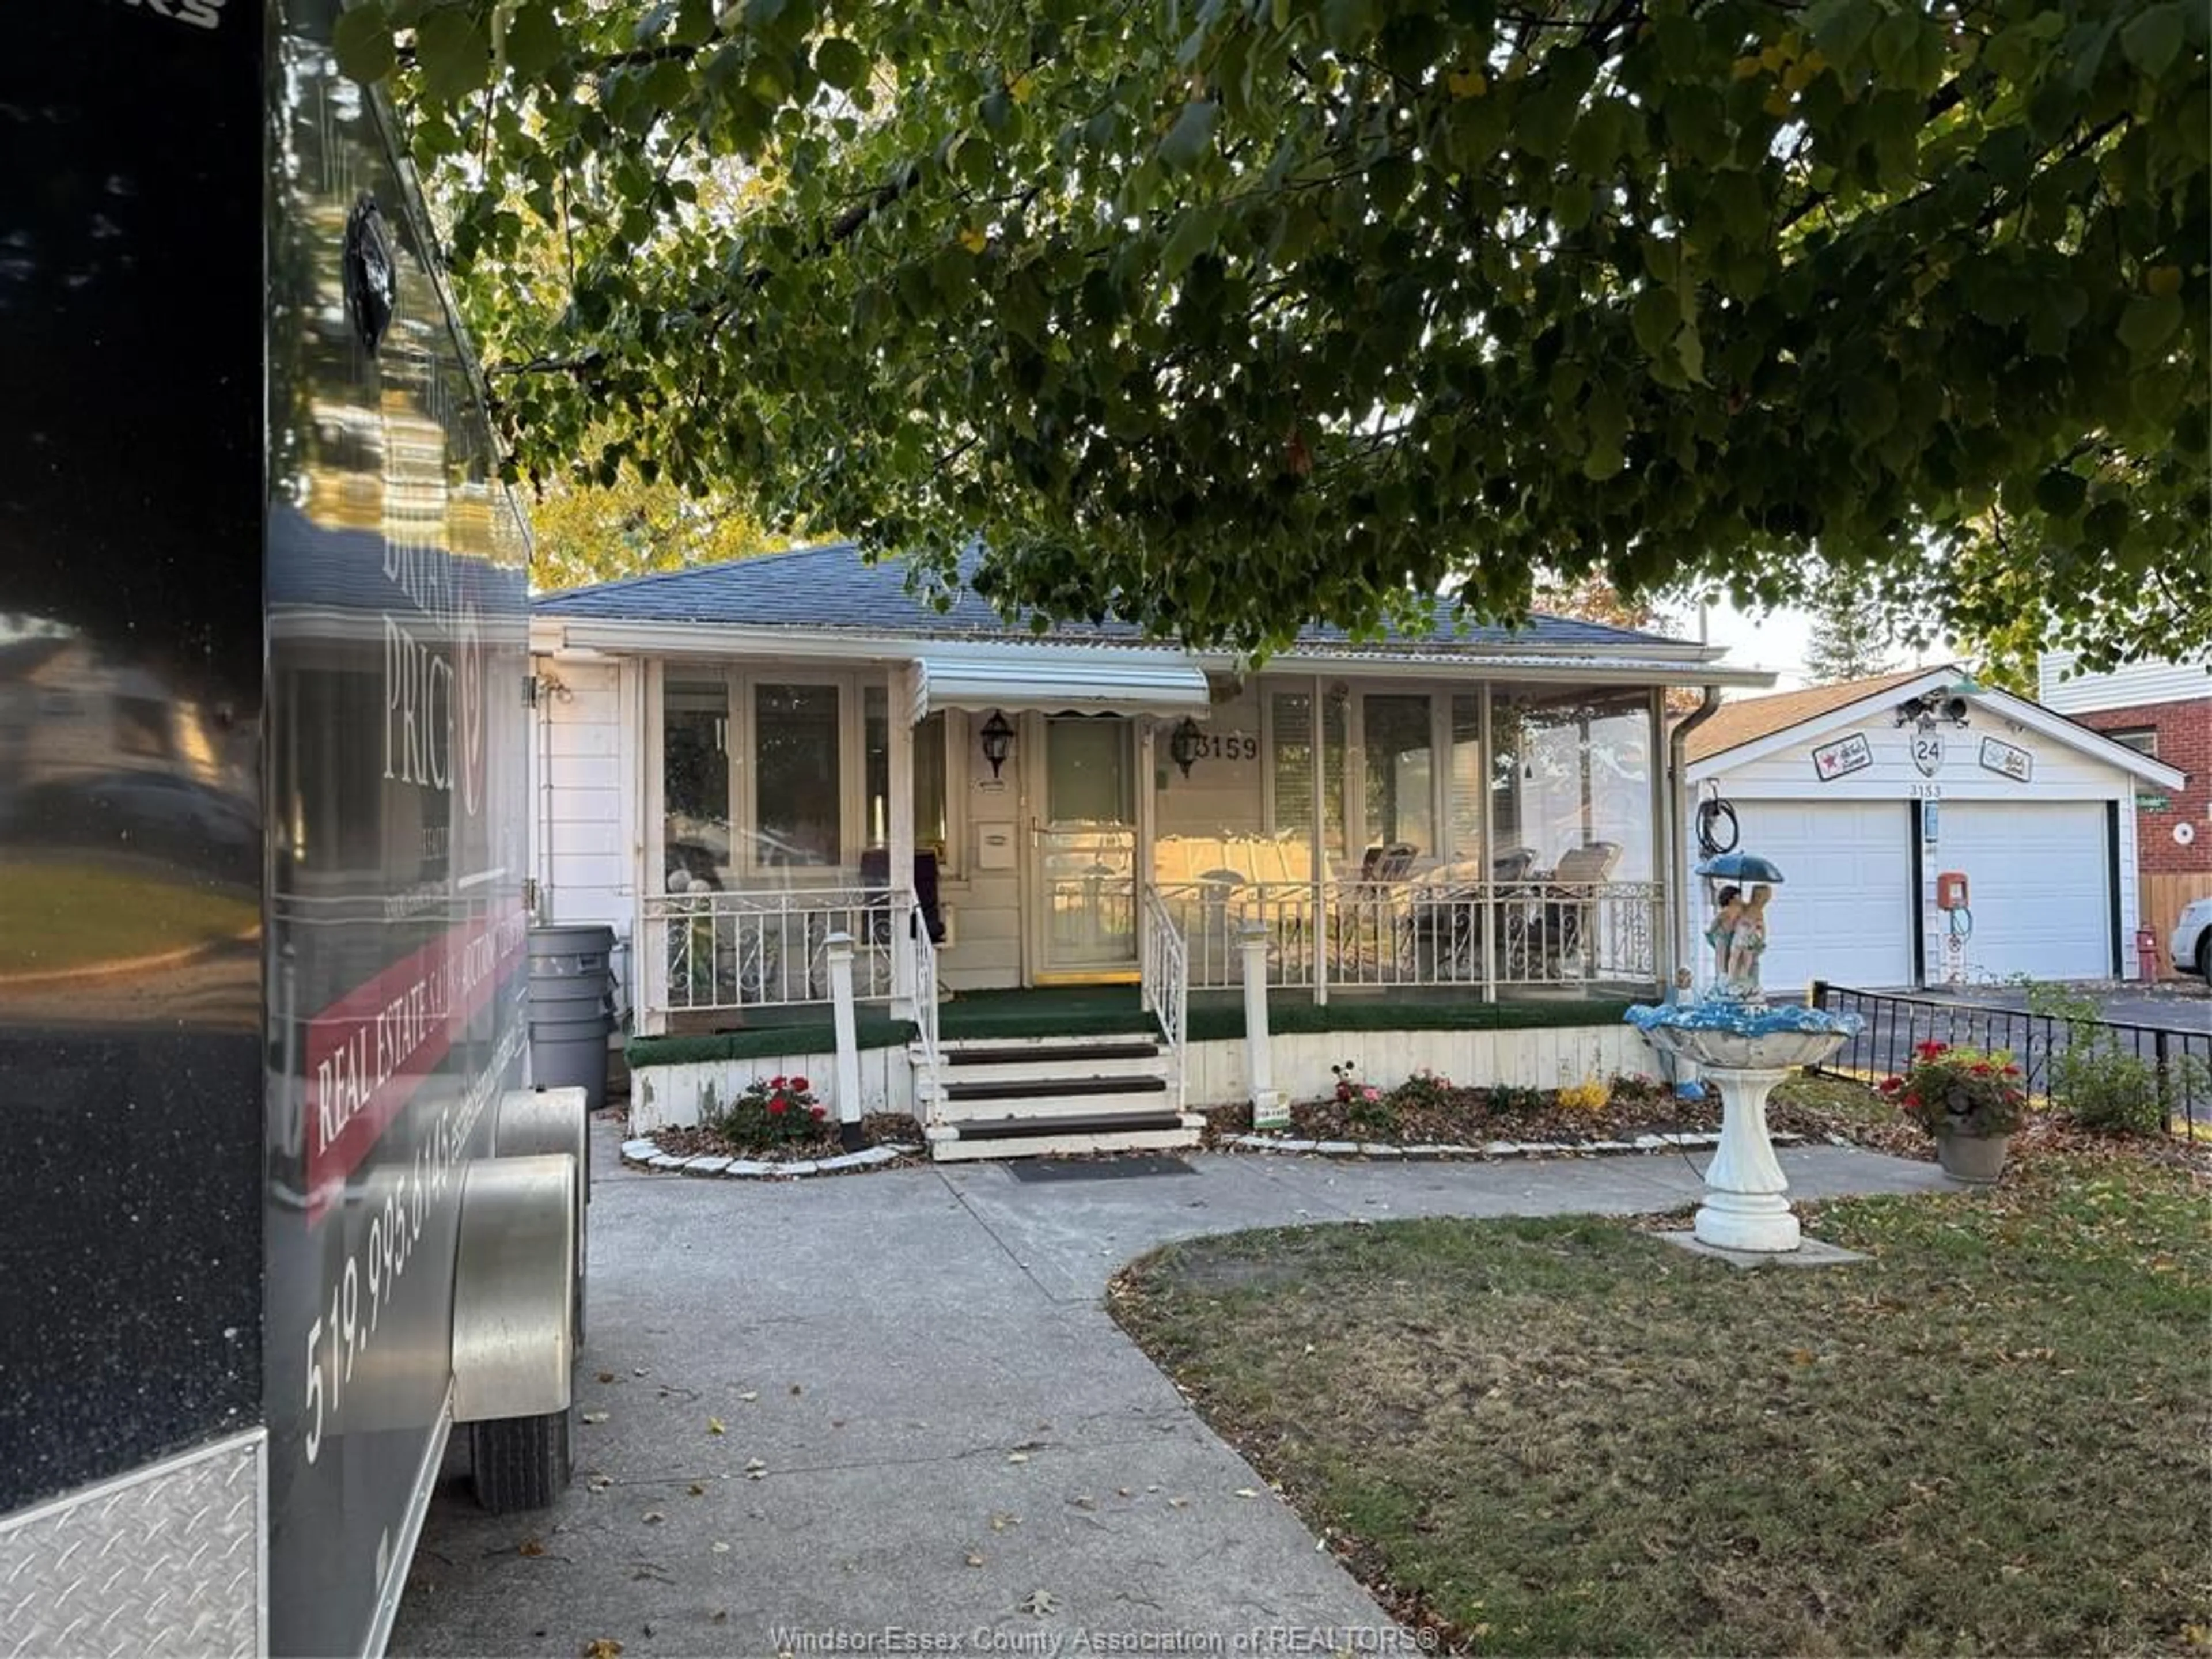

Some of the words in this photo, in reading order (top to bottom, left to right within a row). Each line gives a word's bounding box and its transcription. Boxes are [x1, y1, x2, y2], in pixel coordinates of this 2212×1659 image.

[1195, 734, 1257, 760] 3159
[1917, 740, 1939, 760] 24
[317, 1026, 372, 1158] REAL
[376, 980, 426, 1089] ESTATE
[306, 1106, 449, 1465] 519.995.6145
